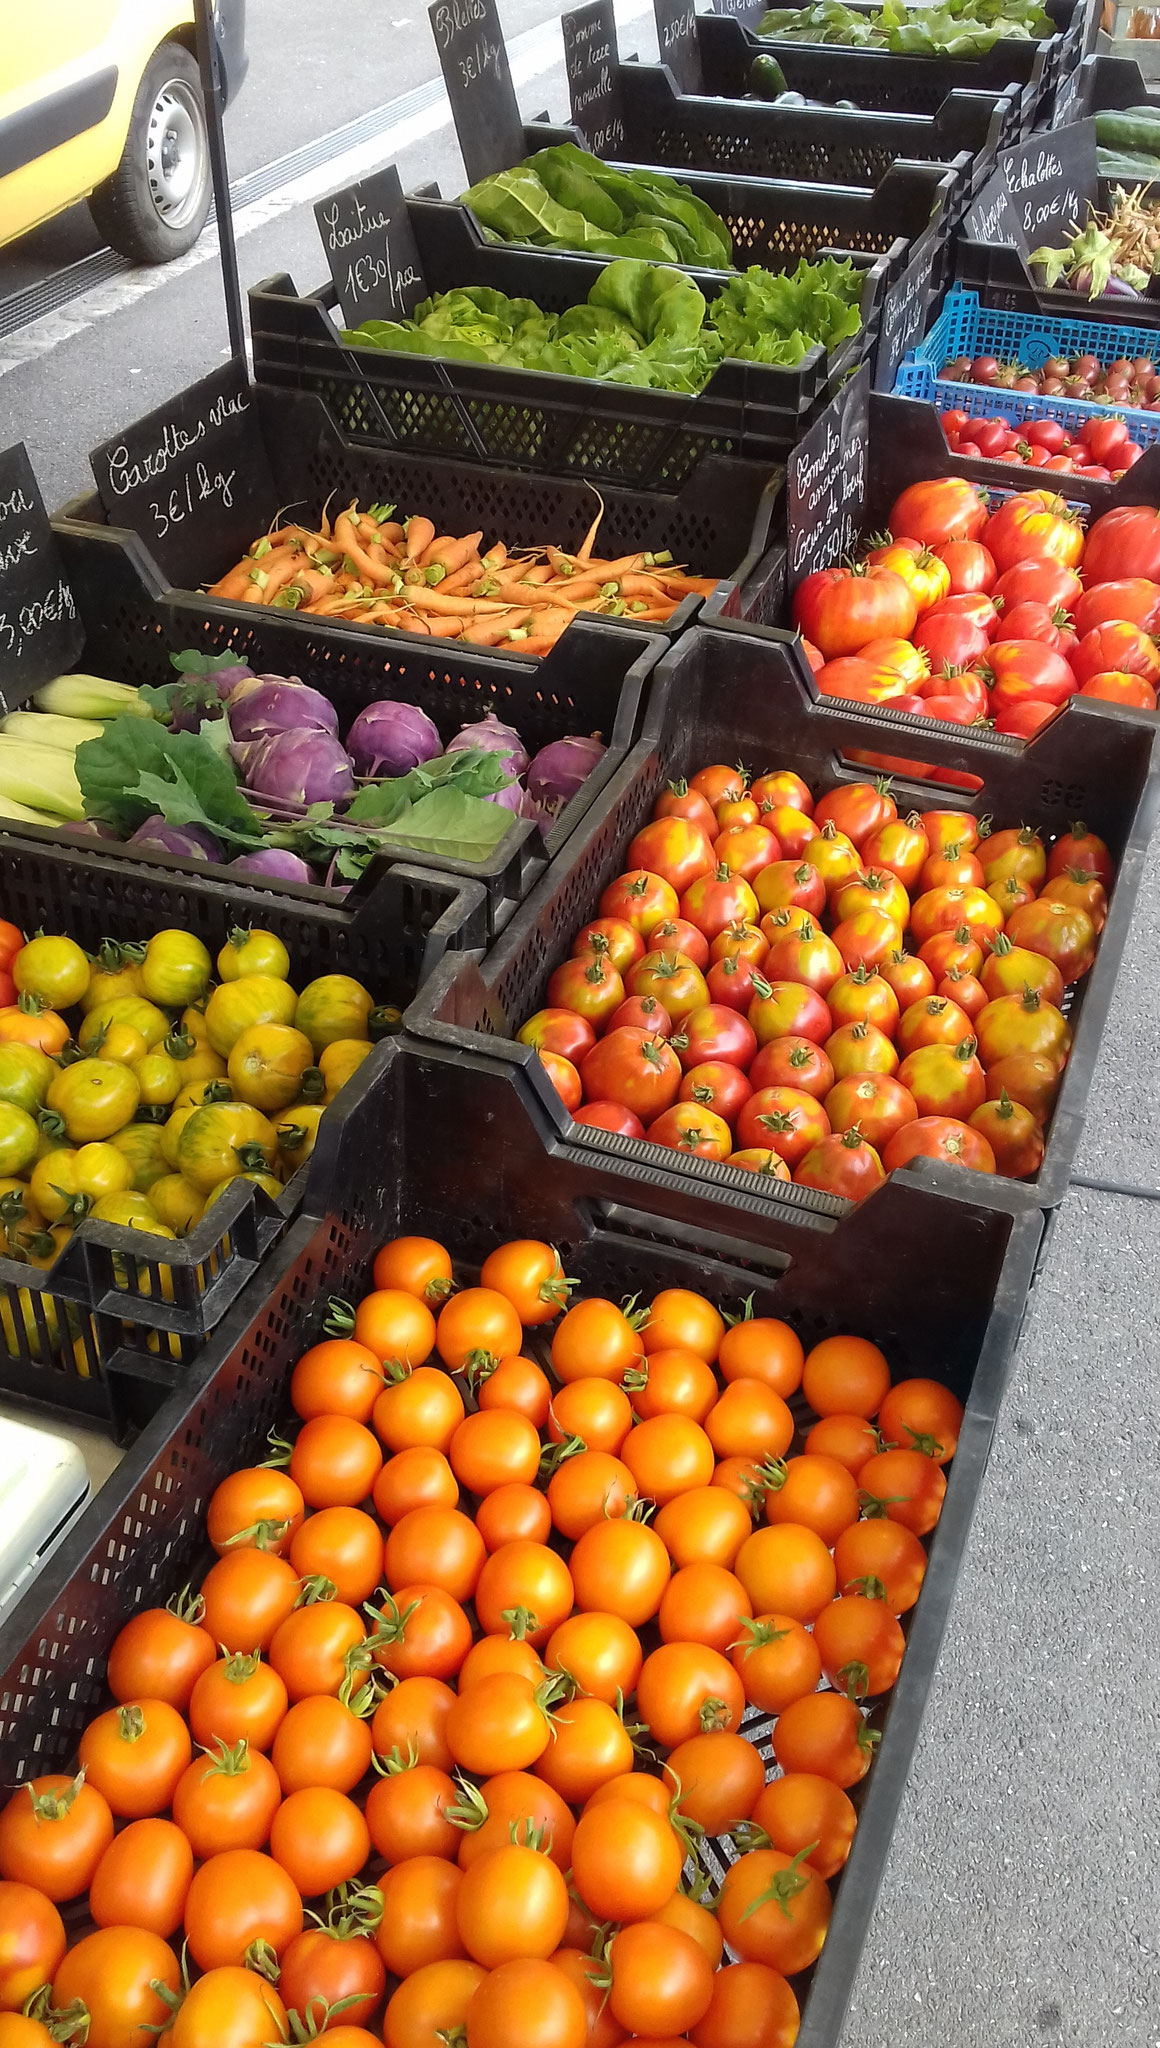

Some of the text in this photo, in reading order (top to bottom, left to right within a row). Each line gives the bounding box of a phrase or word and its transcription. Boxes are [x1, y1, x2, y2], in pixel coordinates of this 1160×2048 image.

[323, 195, 391, 250] Laitue
[107, 391, 251, 495] Carottes vrac
